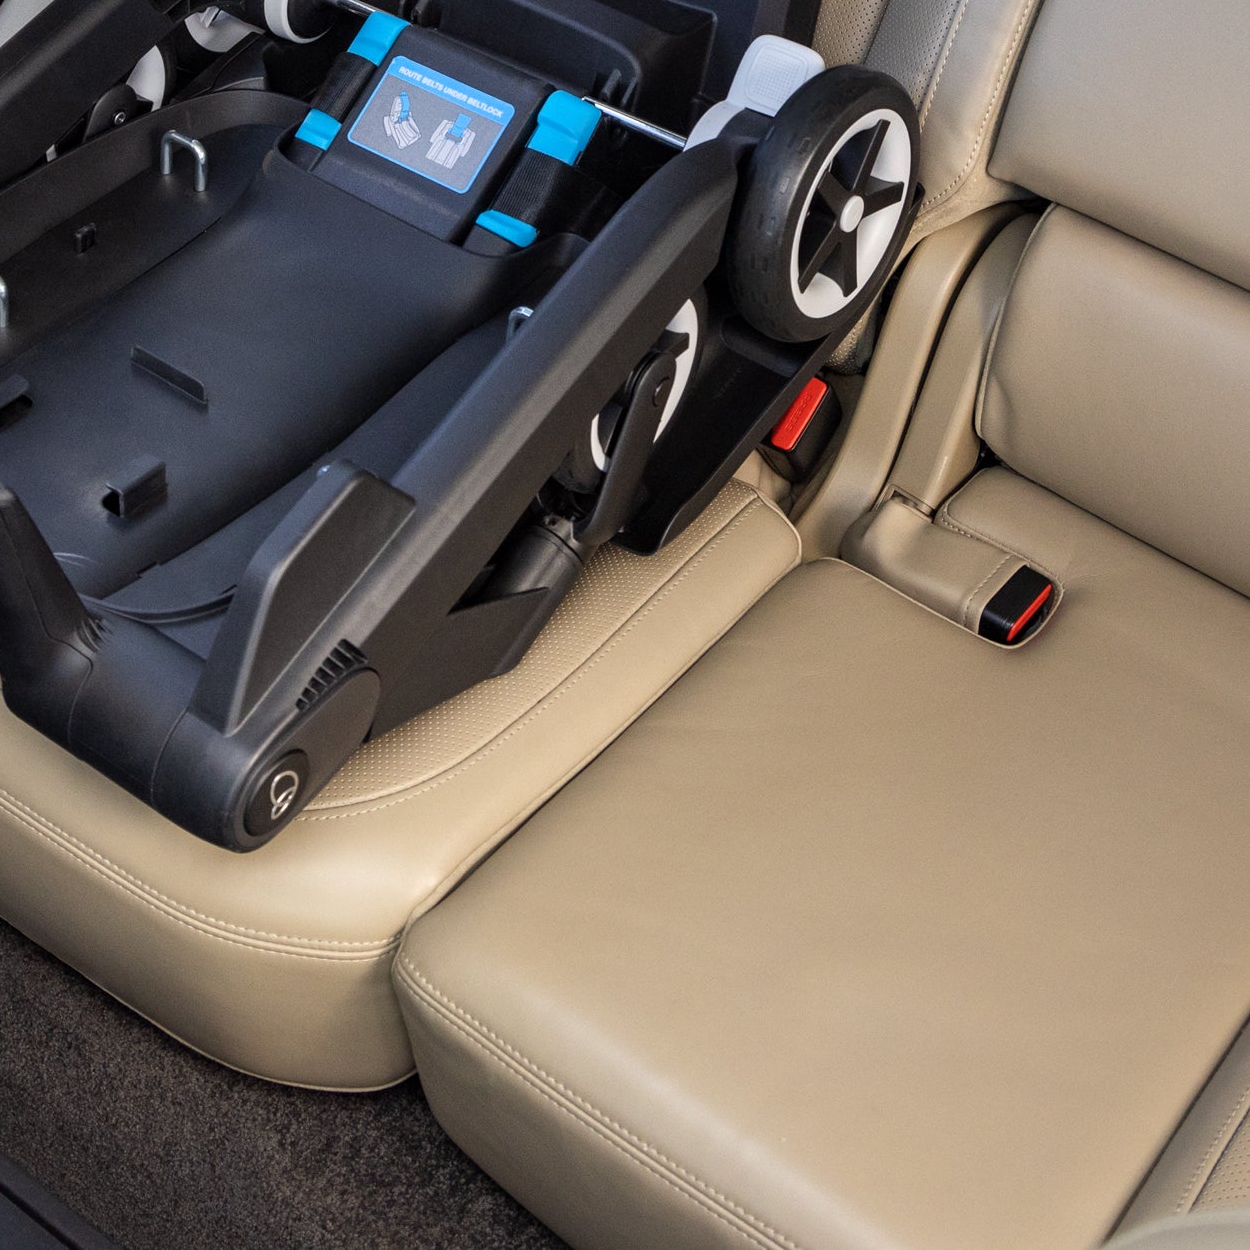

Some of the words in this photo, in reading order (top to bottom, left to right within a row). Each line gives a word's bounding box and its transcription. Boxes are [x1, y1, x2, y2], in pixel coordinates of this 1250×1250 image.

[398, 66, 423, 81] ROUTE
[421, 76, 444, 92] BELTS
[443, 86, 468, 102] UNDER
[467, 97, 504, 118] BELTLOCK
